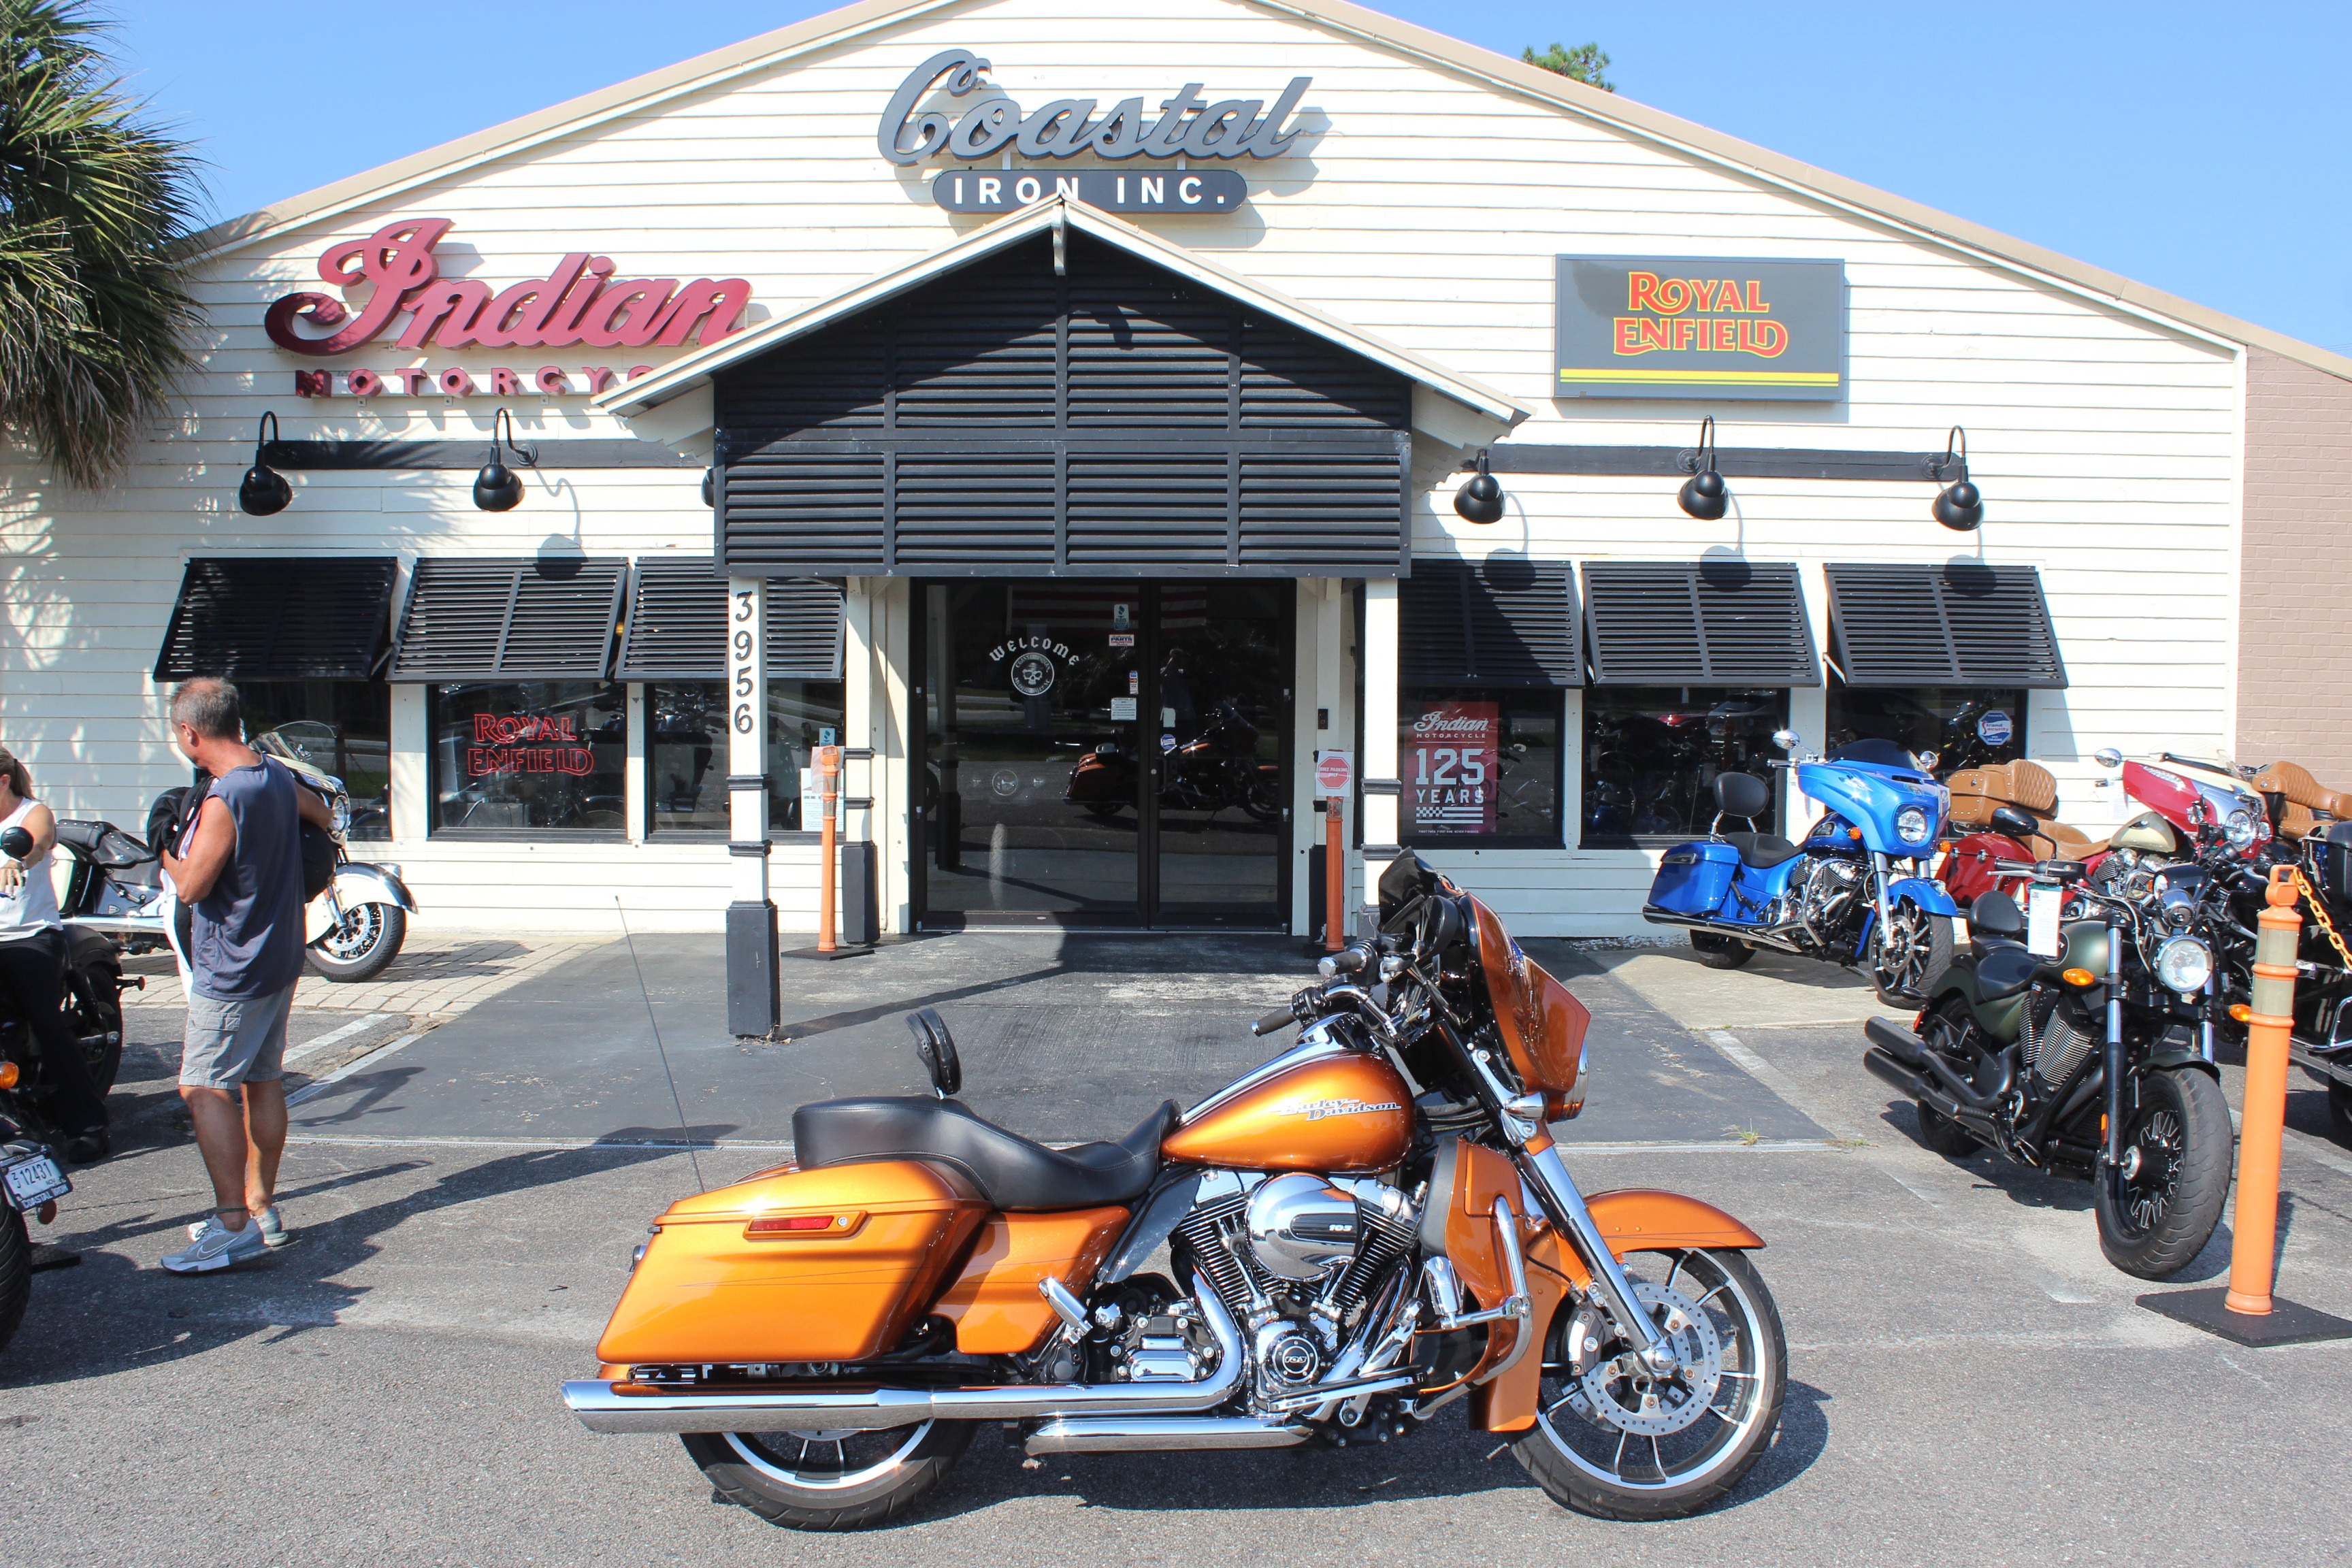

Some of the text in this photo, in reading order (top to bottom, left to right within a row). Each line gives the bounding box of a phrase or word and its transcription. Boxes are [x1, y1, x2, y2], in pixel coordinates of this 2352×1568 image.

[877, 49, 1313, 166] Coastal
[955, 176, 1225, 204] IRON INC.
[265, 218, 753, 356] Indian
[1628, 271, 1770, 315] ROYAL
[1613, 316, 1788, 358] ENFIELD
[734, 591, 753, 734] 3956
[989, 636, 1081, 666] WELCOME
[474, 713, 578, 744] ROYAL
[1414, 710, 1489, 732] Indian
[468, 748, 595, 777] ENFIELD
[1416, 748, 1485, 785] 125
[1416, 789, 1484, 804] YEARS
[1306, 1102, 1401, 1121] Davidson
[20, 1162, 52, 1185] 12431
[22, 1184, 69, 1208] COASTAL IRON
[1329, 1224, 1353, 1232] 105
